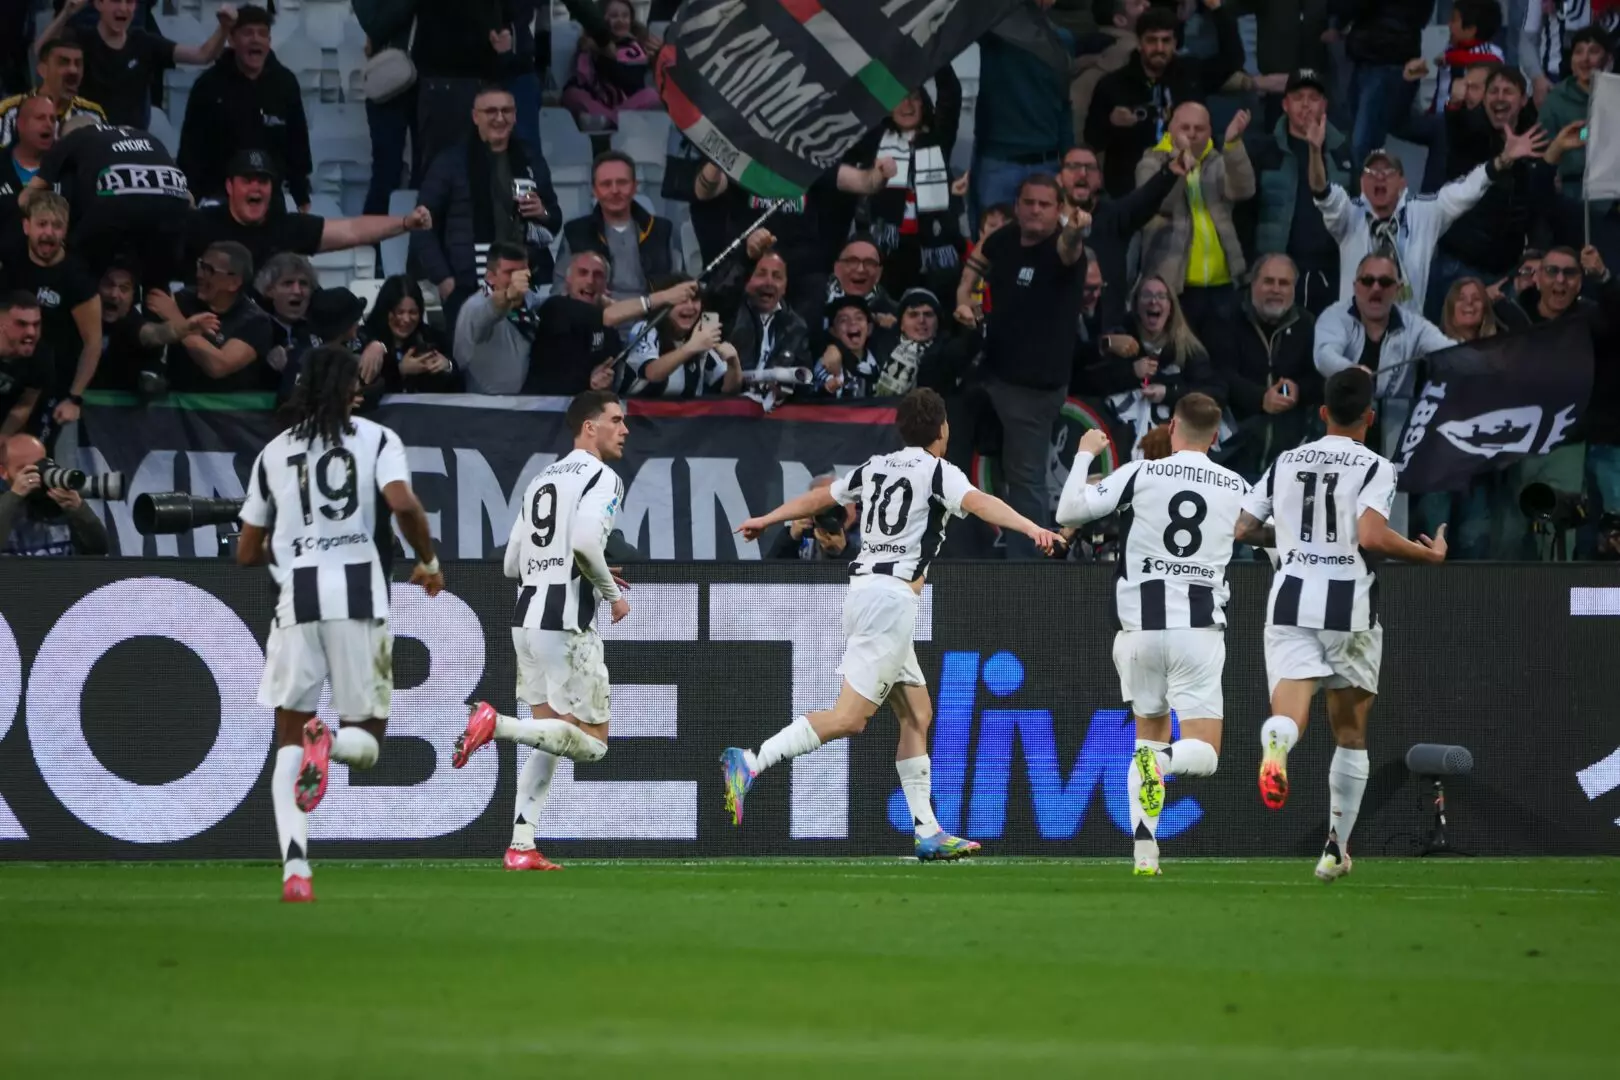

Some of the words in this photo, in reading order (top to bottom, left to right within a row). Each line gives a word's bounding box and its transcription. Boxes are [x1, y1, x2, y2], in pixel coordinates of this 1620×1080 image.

[287, 446, 360, 526] 19
[865, 472, 913, 536] 10
[1146, 462, 1239, 491] KOOPMEINERS
[1296, 471, 1340, 543] 11
[531, 482, 558, 548] 9
[1163, 490, 1207, 558] 8
[1154, 559, 1216, 579] Cygames
